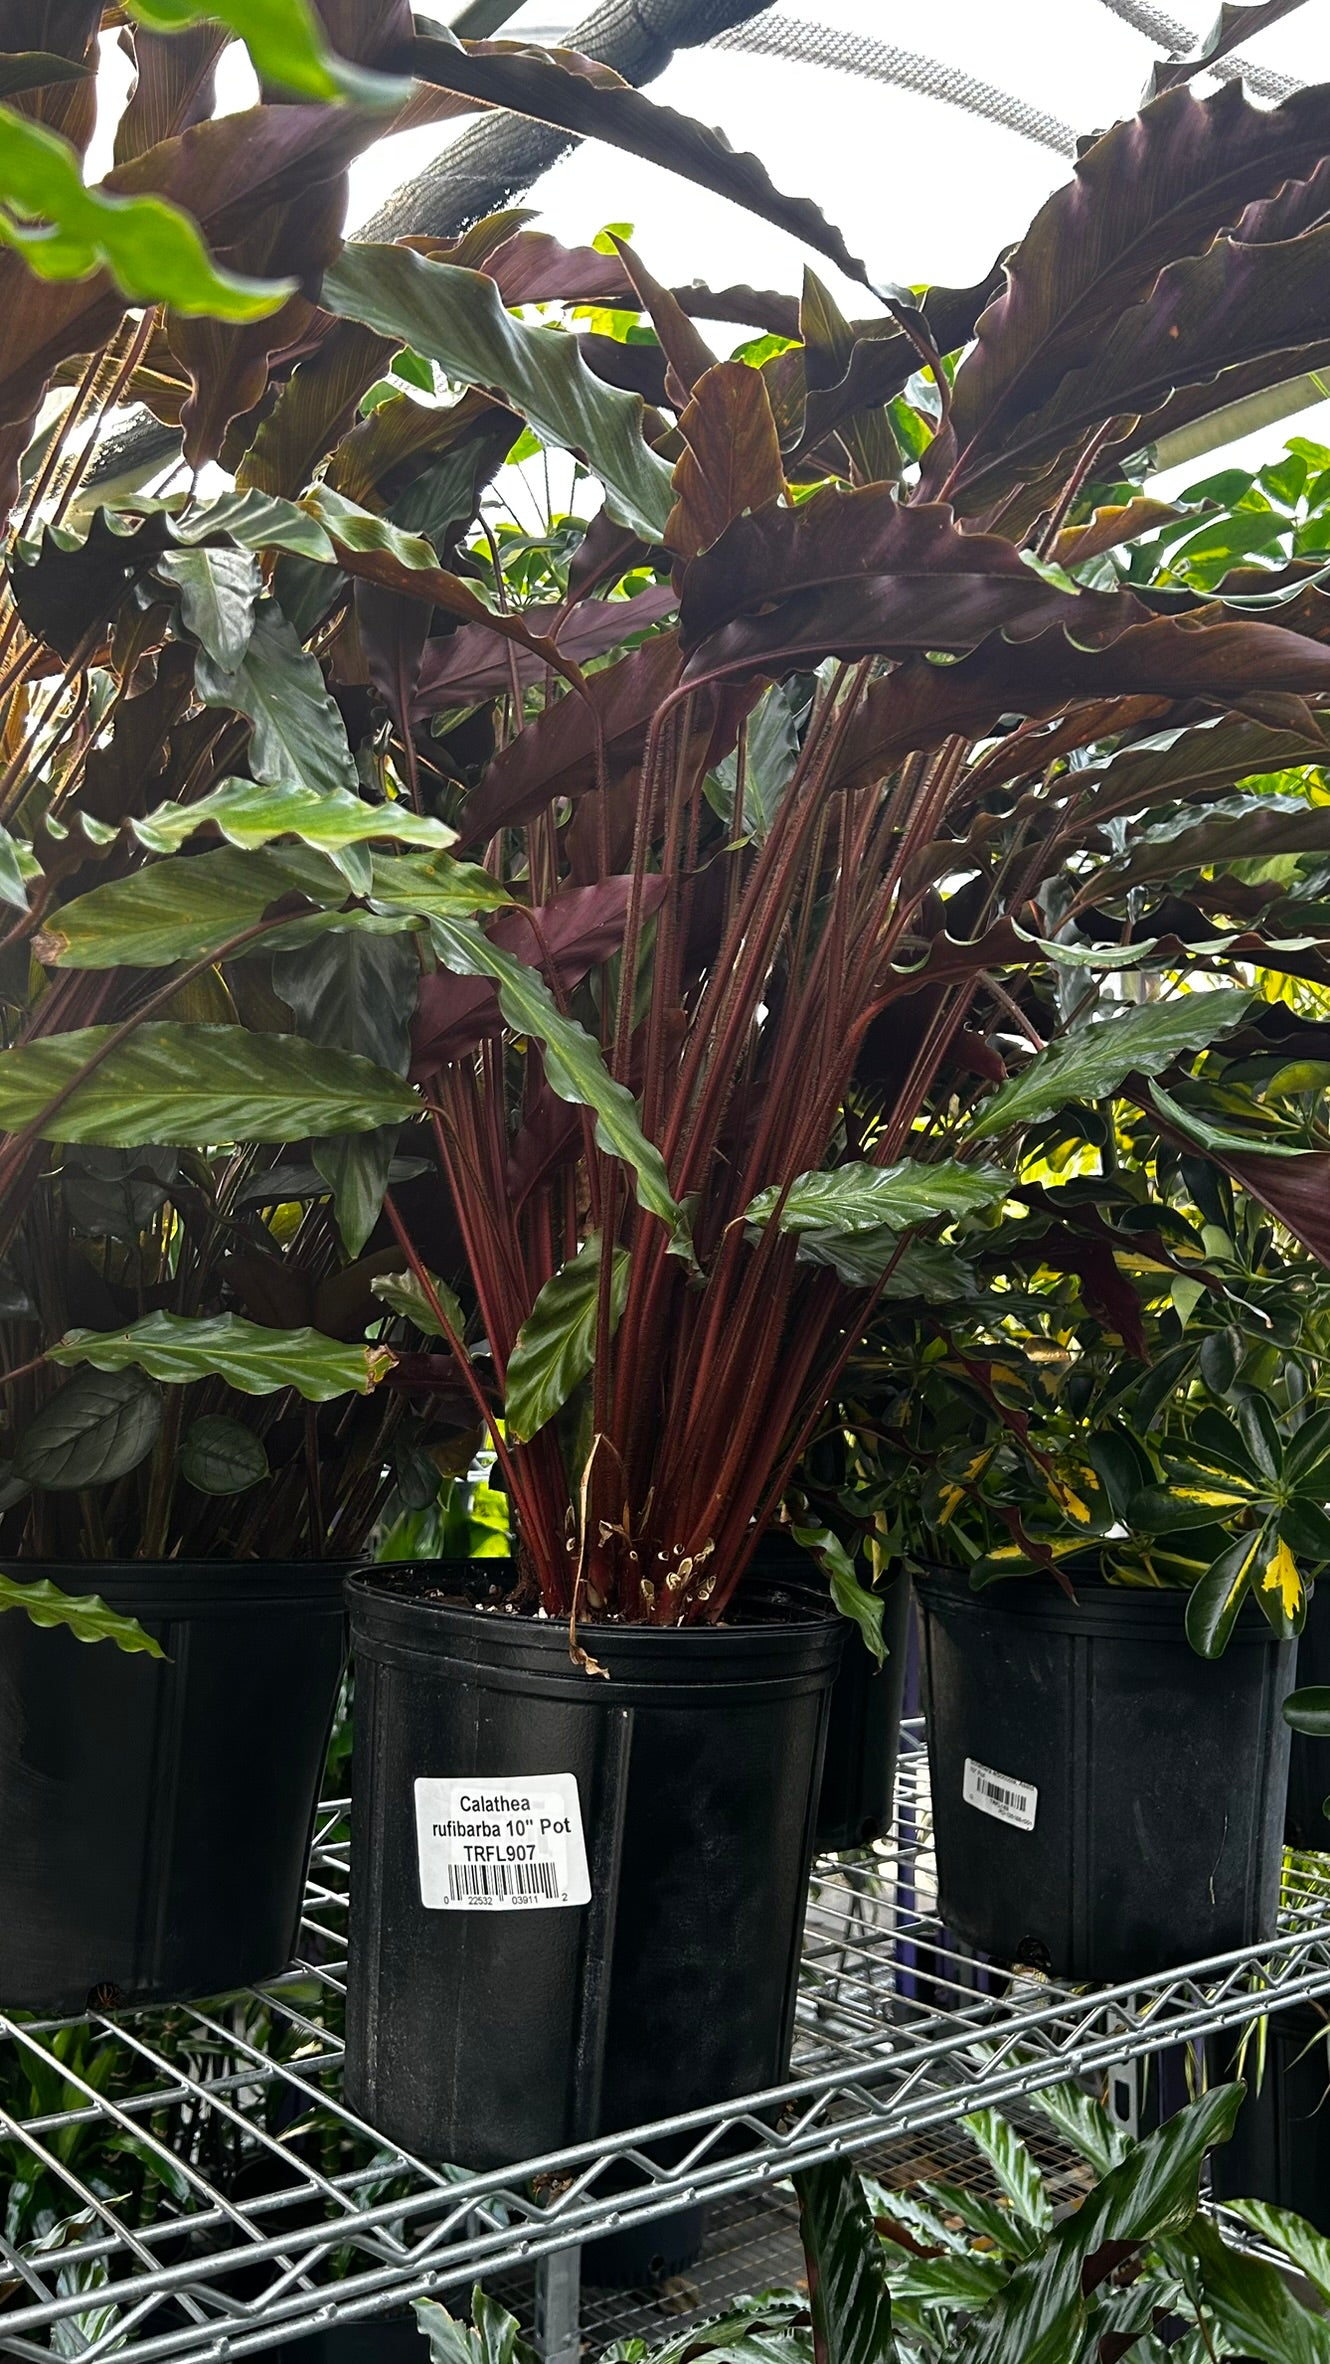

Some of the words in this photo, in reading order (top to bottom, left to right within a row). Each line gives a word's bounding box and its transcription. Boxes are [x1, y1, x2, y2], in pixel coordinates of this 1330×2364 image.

[460, 1795, 530, 1812] Calathea
[433, 1821, 501, 1837] rufibarba
[506, 1819, 533, 1836] 10"
[540, 1817, 572, 1835] Pot
[463, 1844, 536, 1862] TRFL907
[443, 1896, 450, 1904] 0
[468, 1896, 493, 1905] 22532
[512, 1896, 538, 1905] 03911
[561, 1893, 568, 1902] 2
